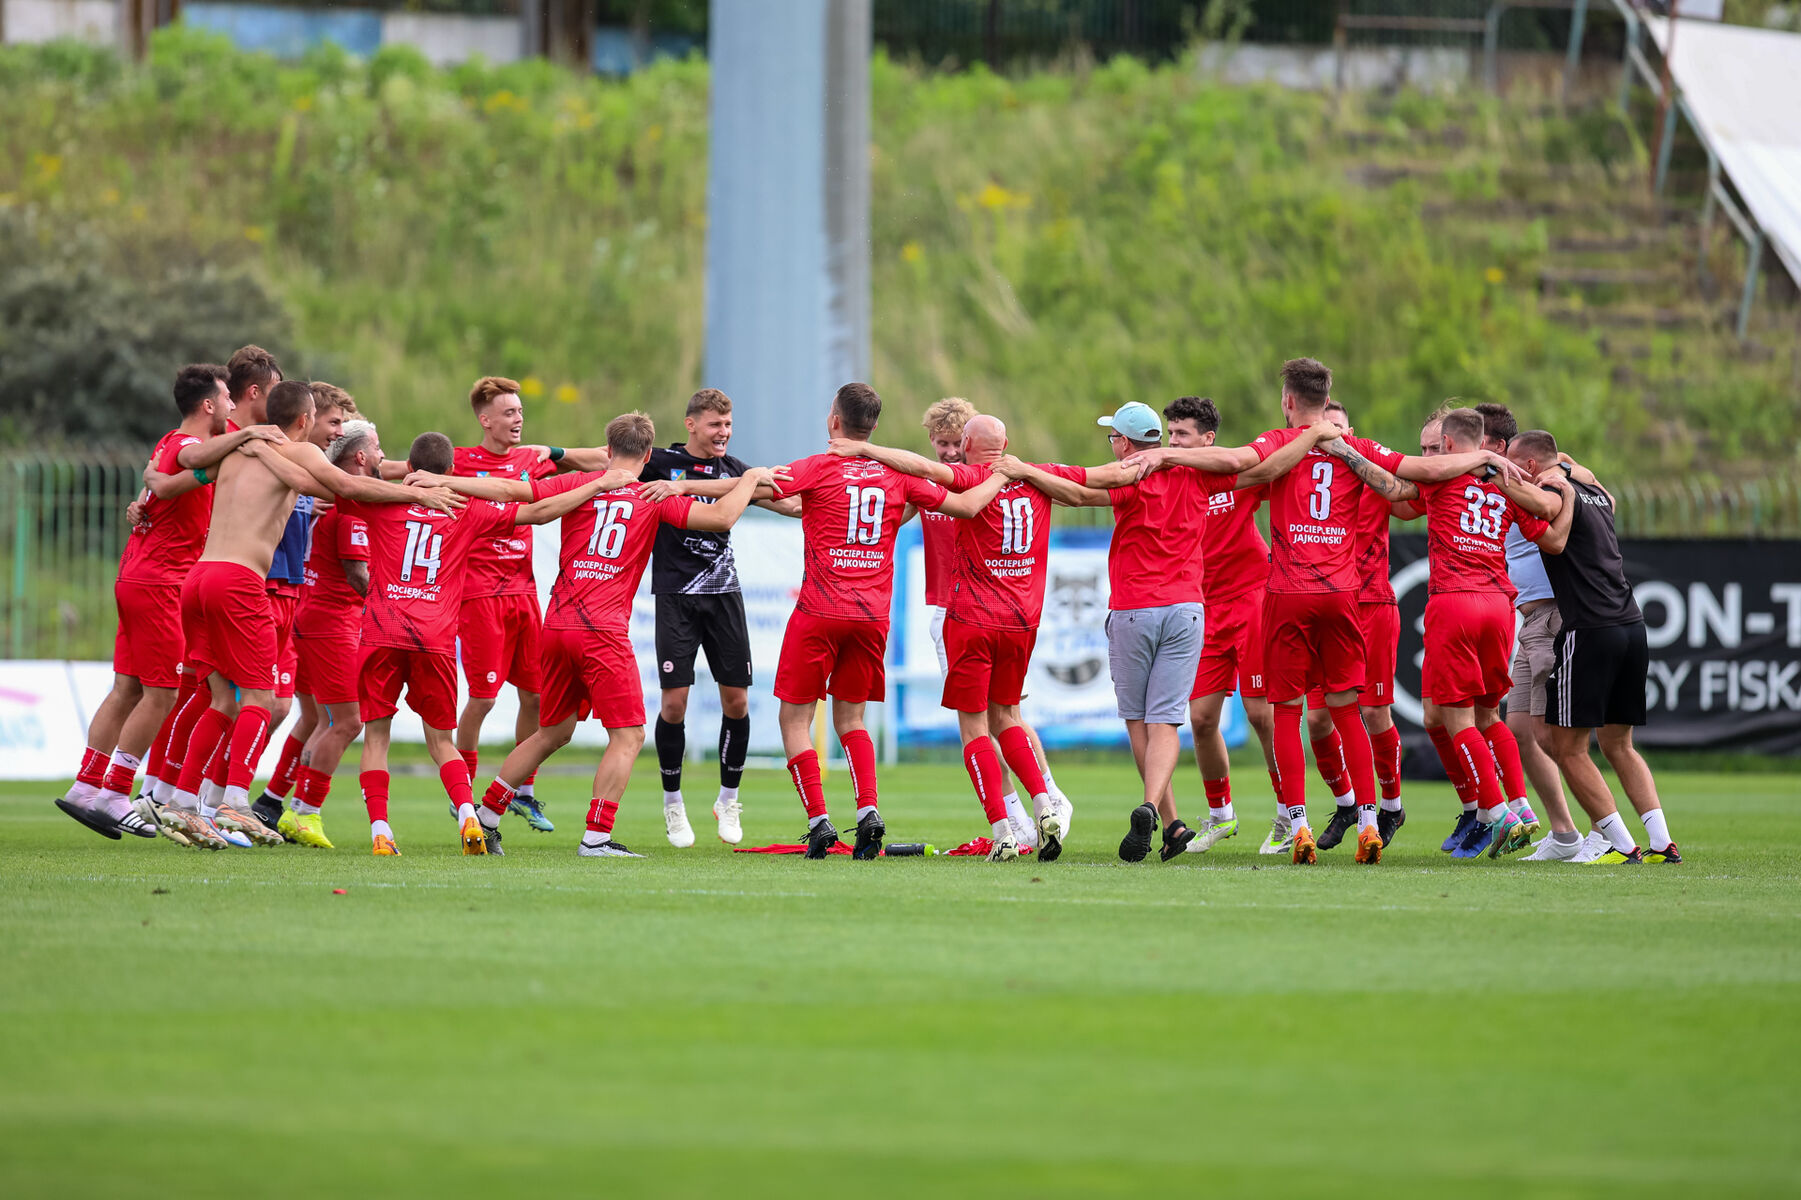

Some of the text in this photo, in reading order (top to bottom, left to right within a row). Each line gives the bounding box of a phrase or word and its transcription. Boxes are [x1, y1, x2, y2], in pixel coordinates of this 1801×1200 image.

[1309, 461, 1334, 521] 3
[845, 485, 886, 545] 19
[1459, 485, 1507, 540] 33
[587, 499, 634, 559] 16
[998, 496, 1035, 555] 10
[1289, 523, 1347, 536] DOCIEPLENIA
[1292, 533, 1343, 545] JAJKOWSKI
[400, 519, 443, 585] 14
[828, 547, 885, 559] DOCIEPLENIA
[832, 557, 882, 569] JAJKOWSKI
[984, 556, 1036, 568] DOCIEPLENIA
[990, 567, 1033, 578] JAJKOWSKI
[1251, 674, 1263, 689] 18
[1699, 660, 1801, 712] FISK
[1376, 682, 1384, 697] 11
[1289, 807, 1304, 819] FS
